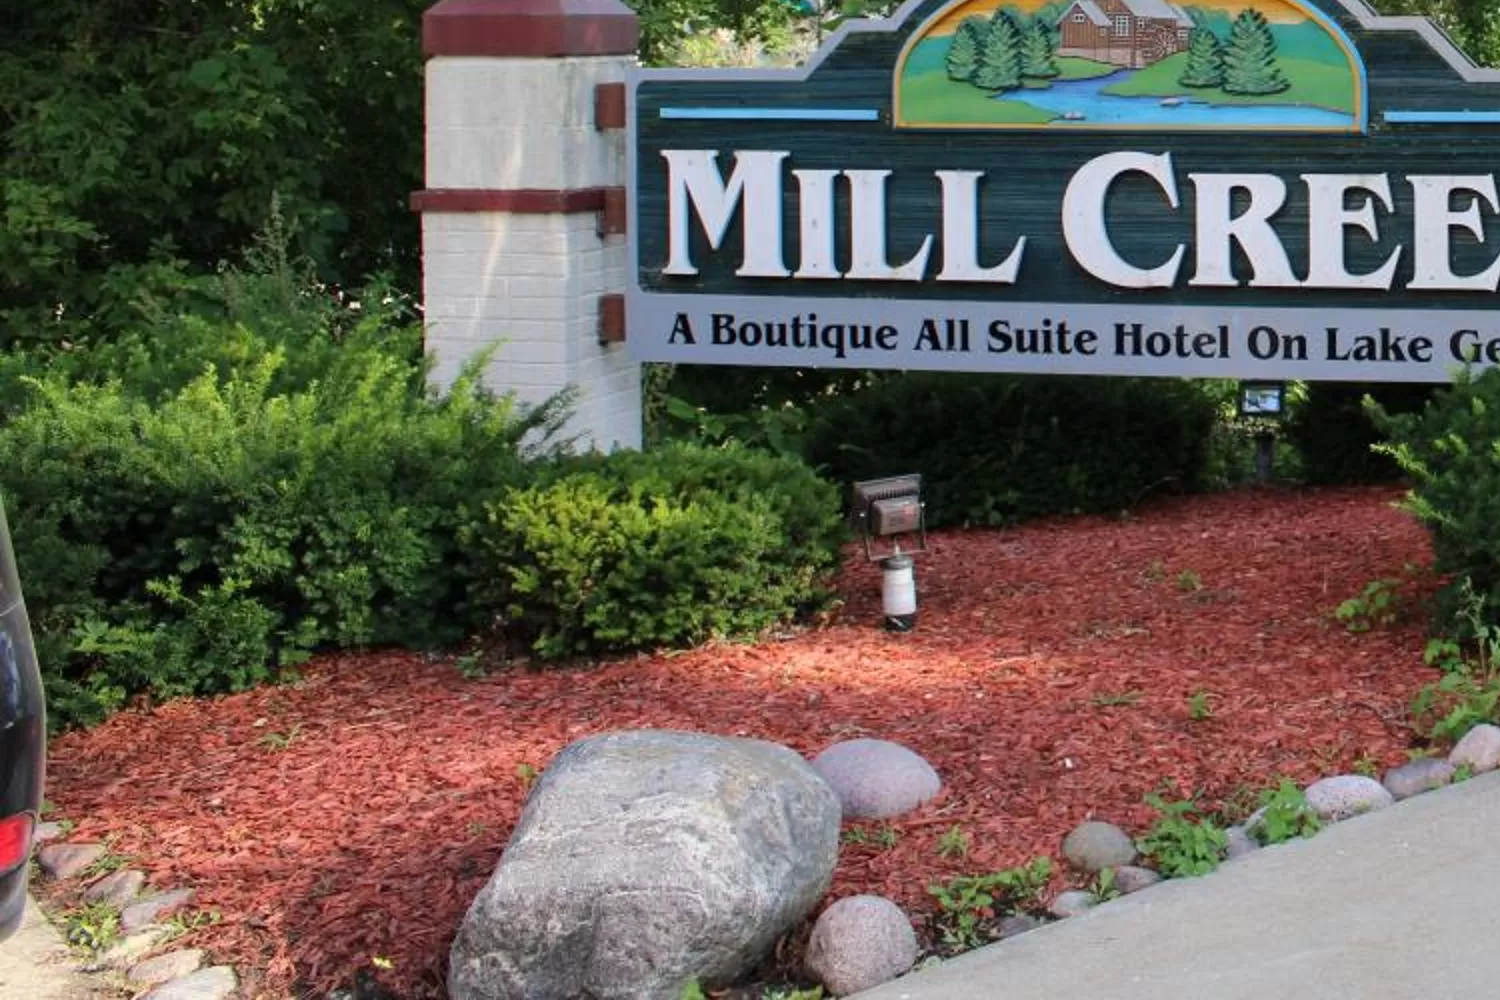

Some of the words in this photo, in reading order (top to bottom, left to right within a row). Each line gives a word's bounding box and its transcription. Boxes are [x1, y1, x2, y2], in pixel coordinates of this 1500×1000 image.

[660, 149, 1027, 284] MILL
[668, 313, 696, 345] A
[711, 313, 898, 359] Boutique
[913, 319, 970, 352] All
[987, 319, 1098, 356] Suite
[1115, 323, 1229, 358] Hotel
[1247, 326, 1307, 362] On
[1326, 328, 1433, 363] Lake
